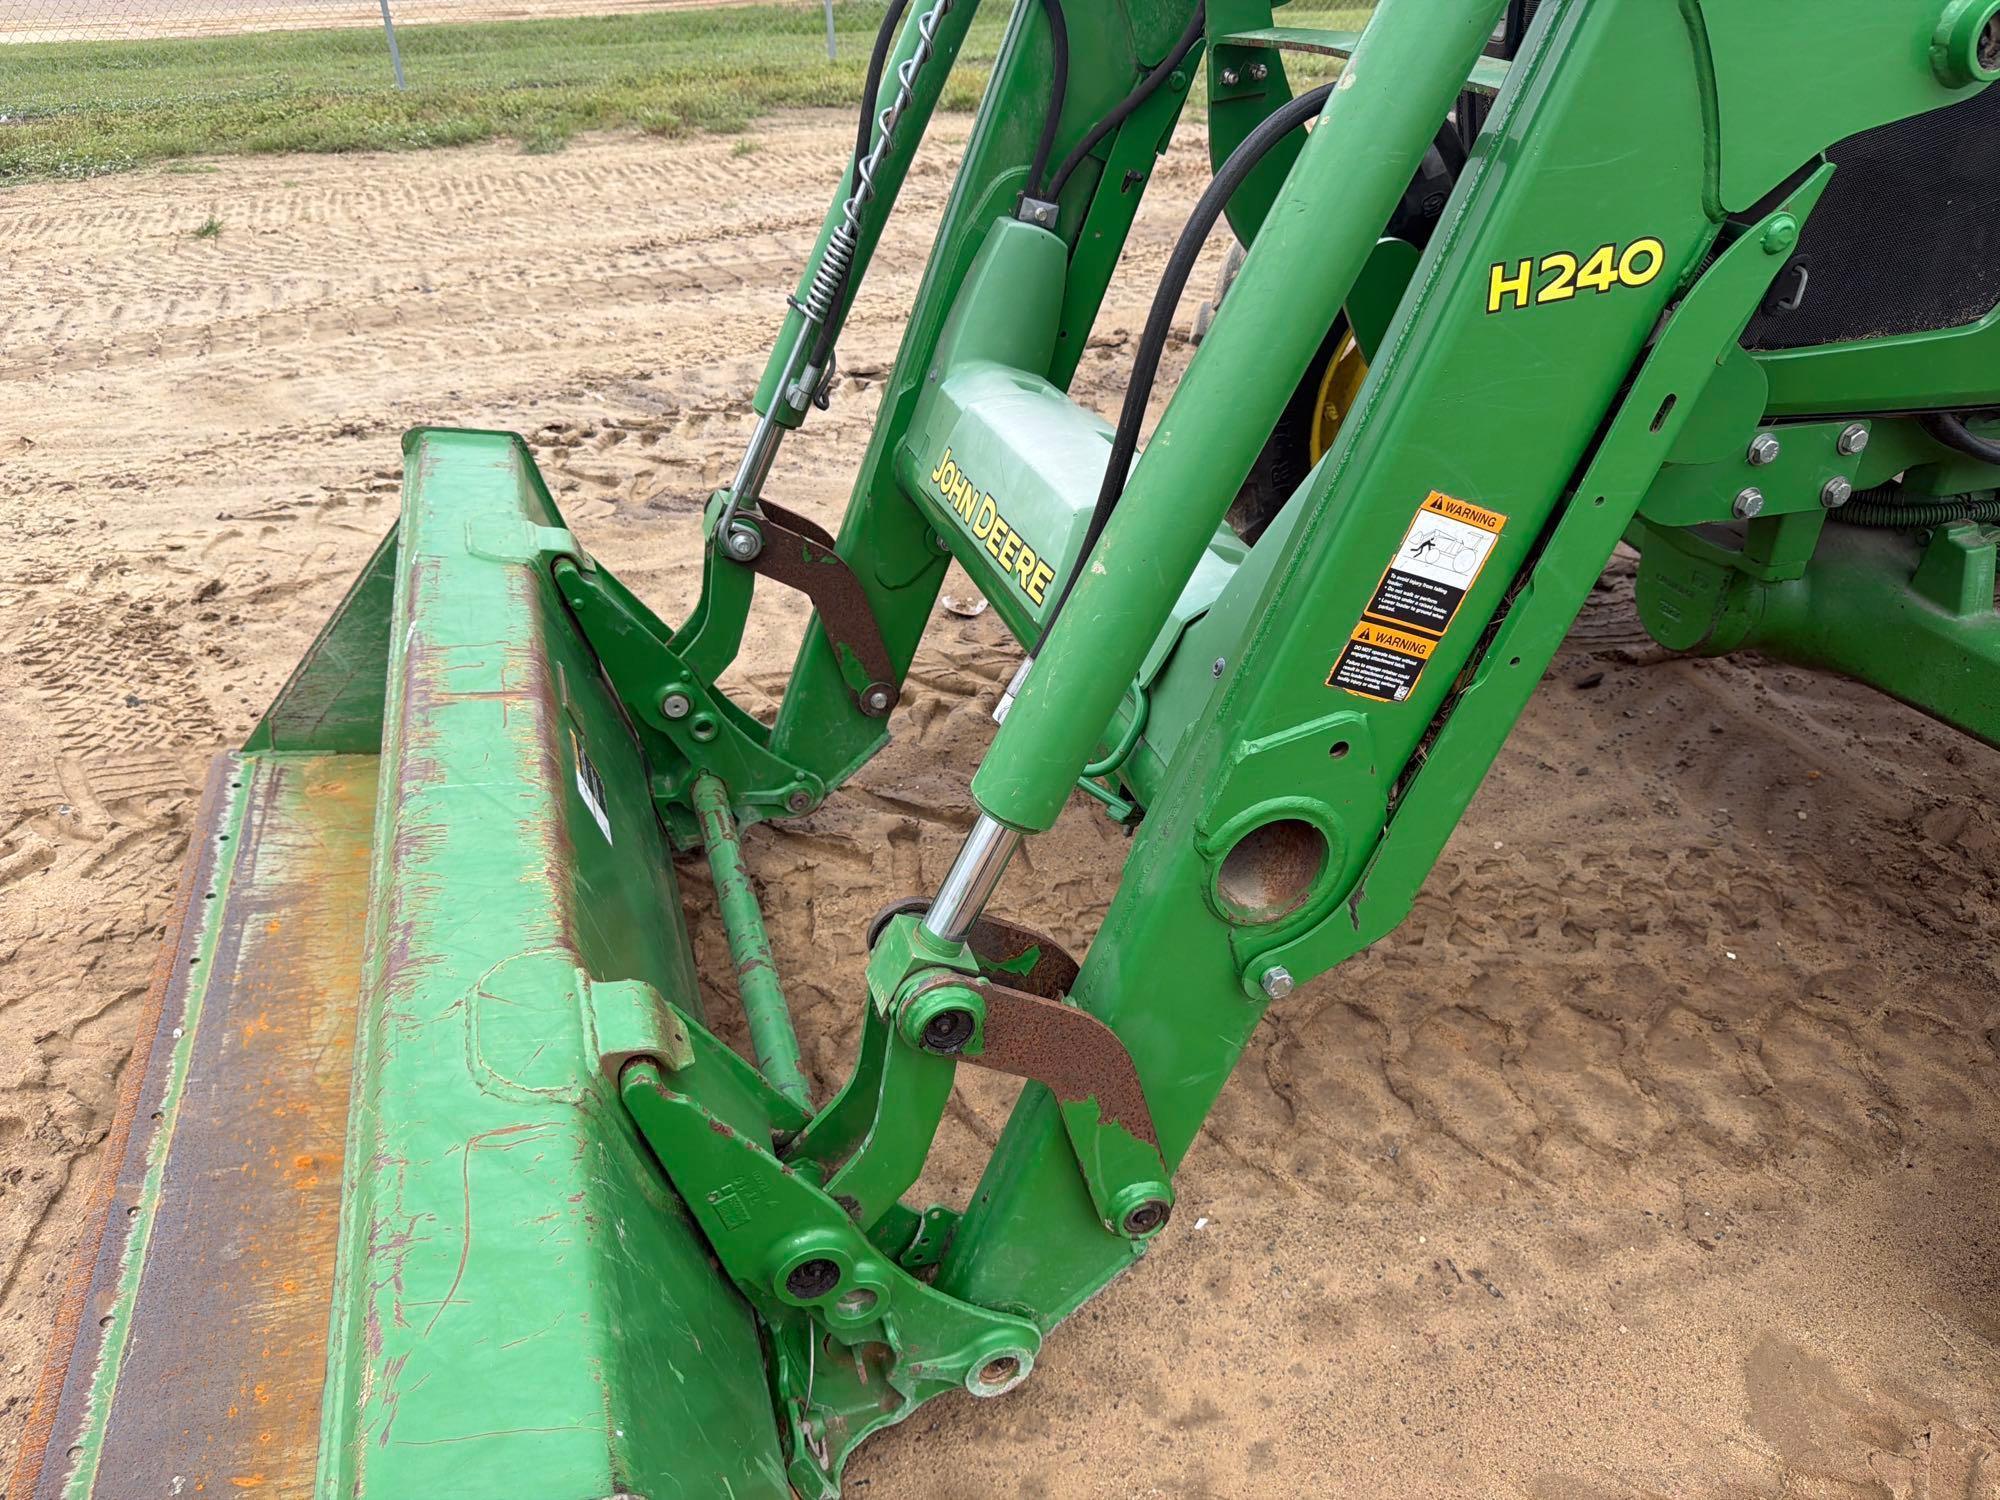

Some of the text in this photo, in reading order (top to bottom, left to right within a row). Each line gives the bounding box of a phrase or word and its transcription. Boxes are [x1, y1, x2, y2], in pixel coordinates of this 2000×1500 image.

[1486, 236, 1665, 314] H240
[932, 446, 1056, 607] JOHN DEERE
[1445, 501, 1497, 528] WARNING
[1375, 632, 1427, 655] WARNING
